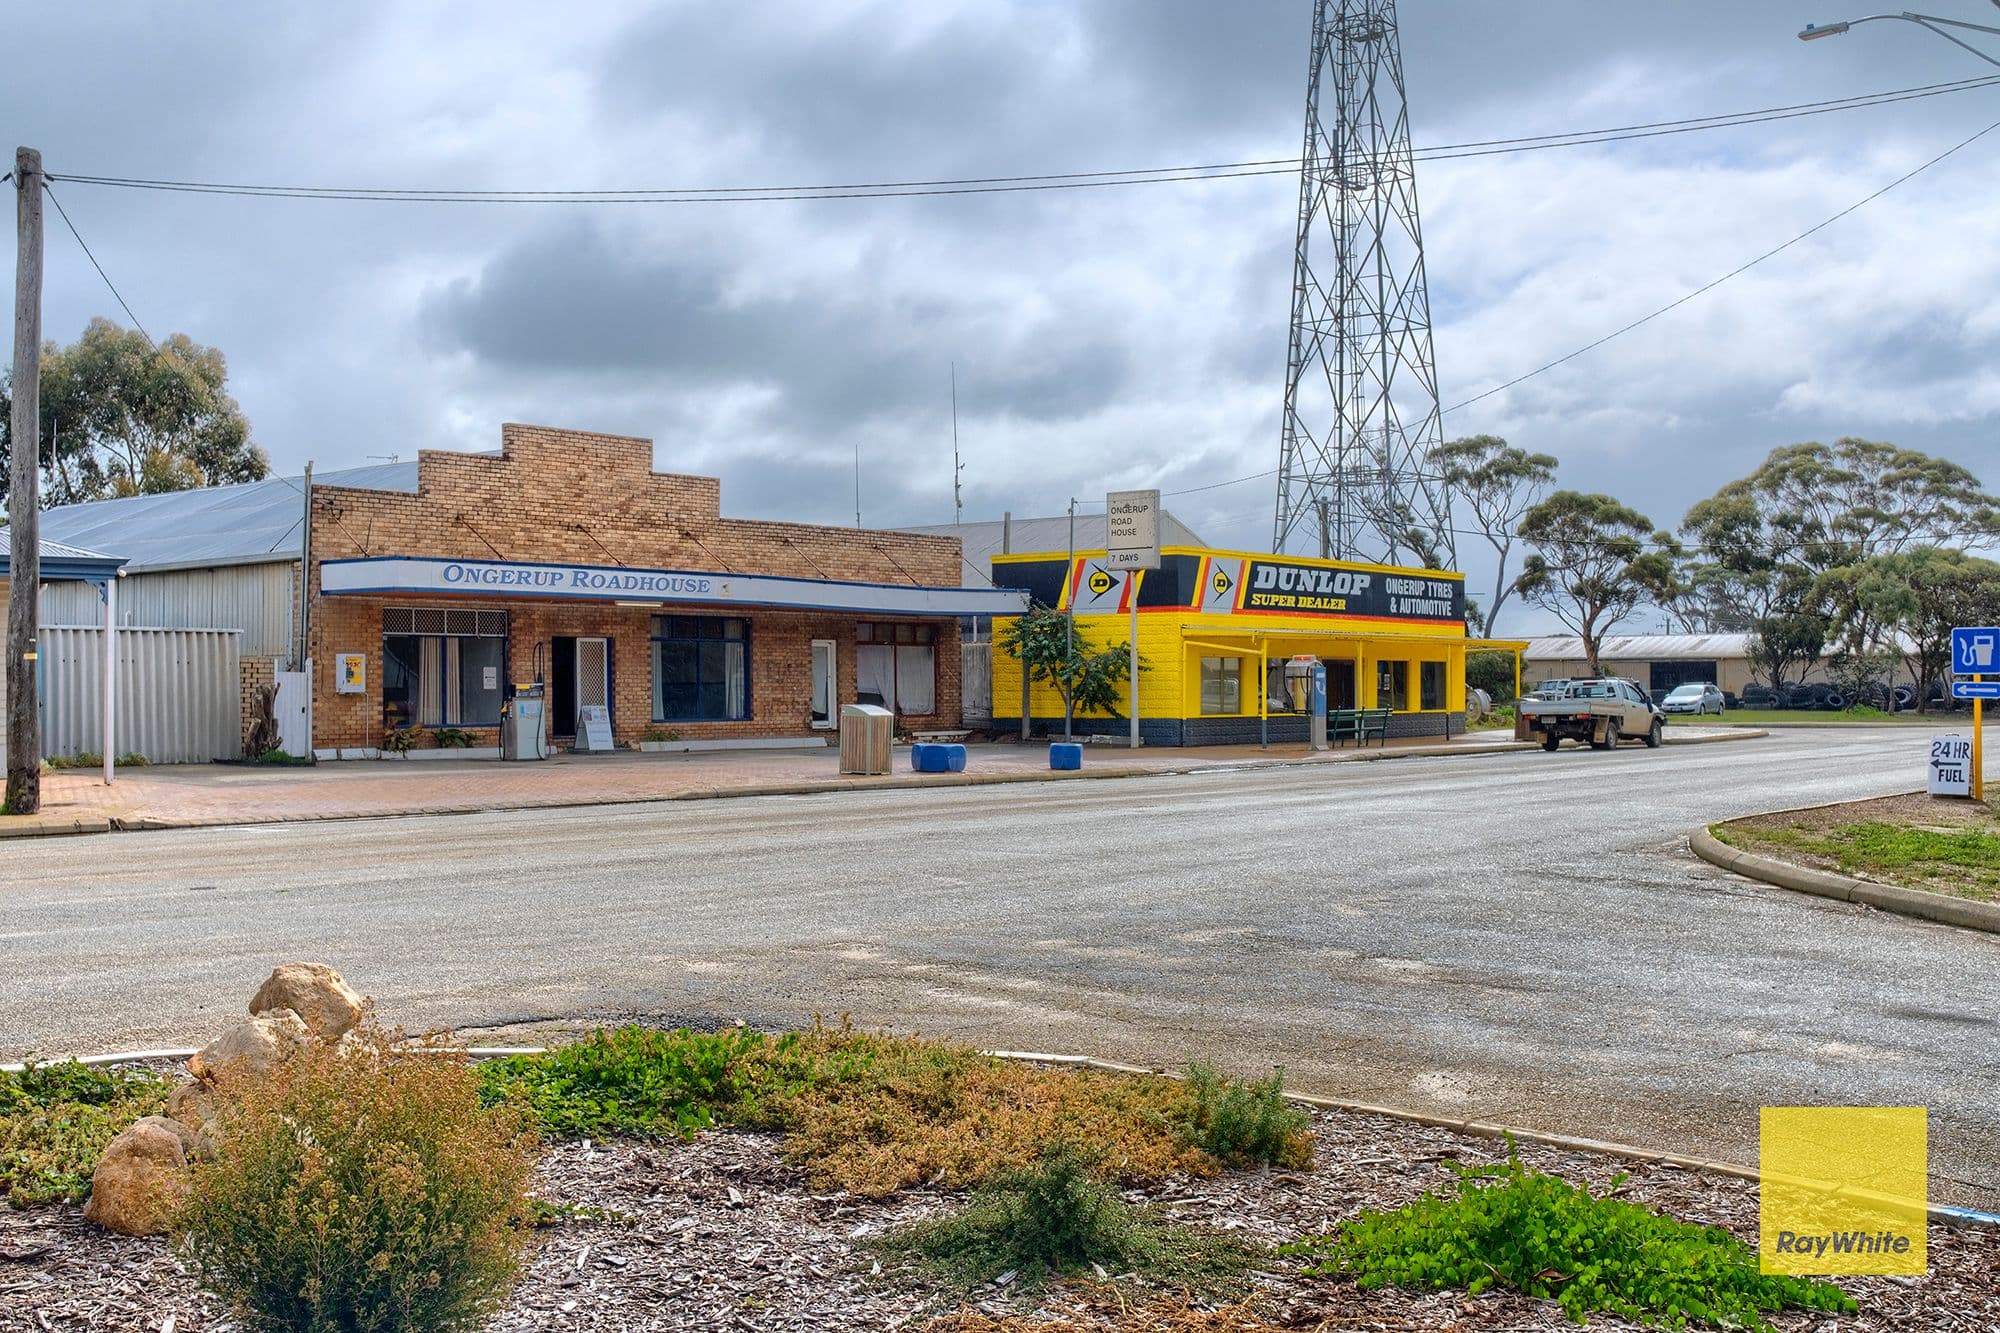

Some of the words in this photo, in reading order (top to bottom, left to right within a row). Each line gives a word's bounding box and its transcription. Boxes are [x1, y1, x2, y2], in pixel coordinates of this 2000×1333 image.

[1111, 505, 1149, 515] ONGERUP
[1111, 518, 1133, 526] ROAD
[1111, 528, 1137, 537] HOUSE
[1119, 553, 1139, 562] DAYS
[443, 564, 563, 586] ONGERUP
[570, 570, 711, 593] ROADHOUSE
[1254, 565, 1371, 596] DUNLOP
[1385, 577, 1425, 595] ONGERUP
[1427, 580, 1454, 598] TYRES
[1251, 593, 1296, 607] SUPER
[1297, 597, 1346, 610] DEALER
[1390, 598, 1397, 613] &
[1399, 599, 1452, 616] AUTOMOTIVE
[1931, 741, 1950, 758] 24
[1953, 742, 1970, 759] HR
[1938, 769, 1965, 783] FUEL
